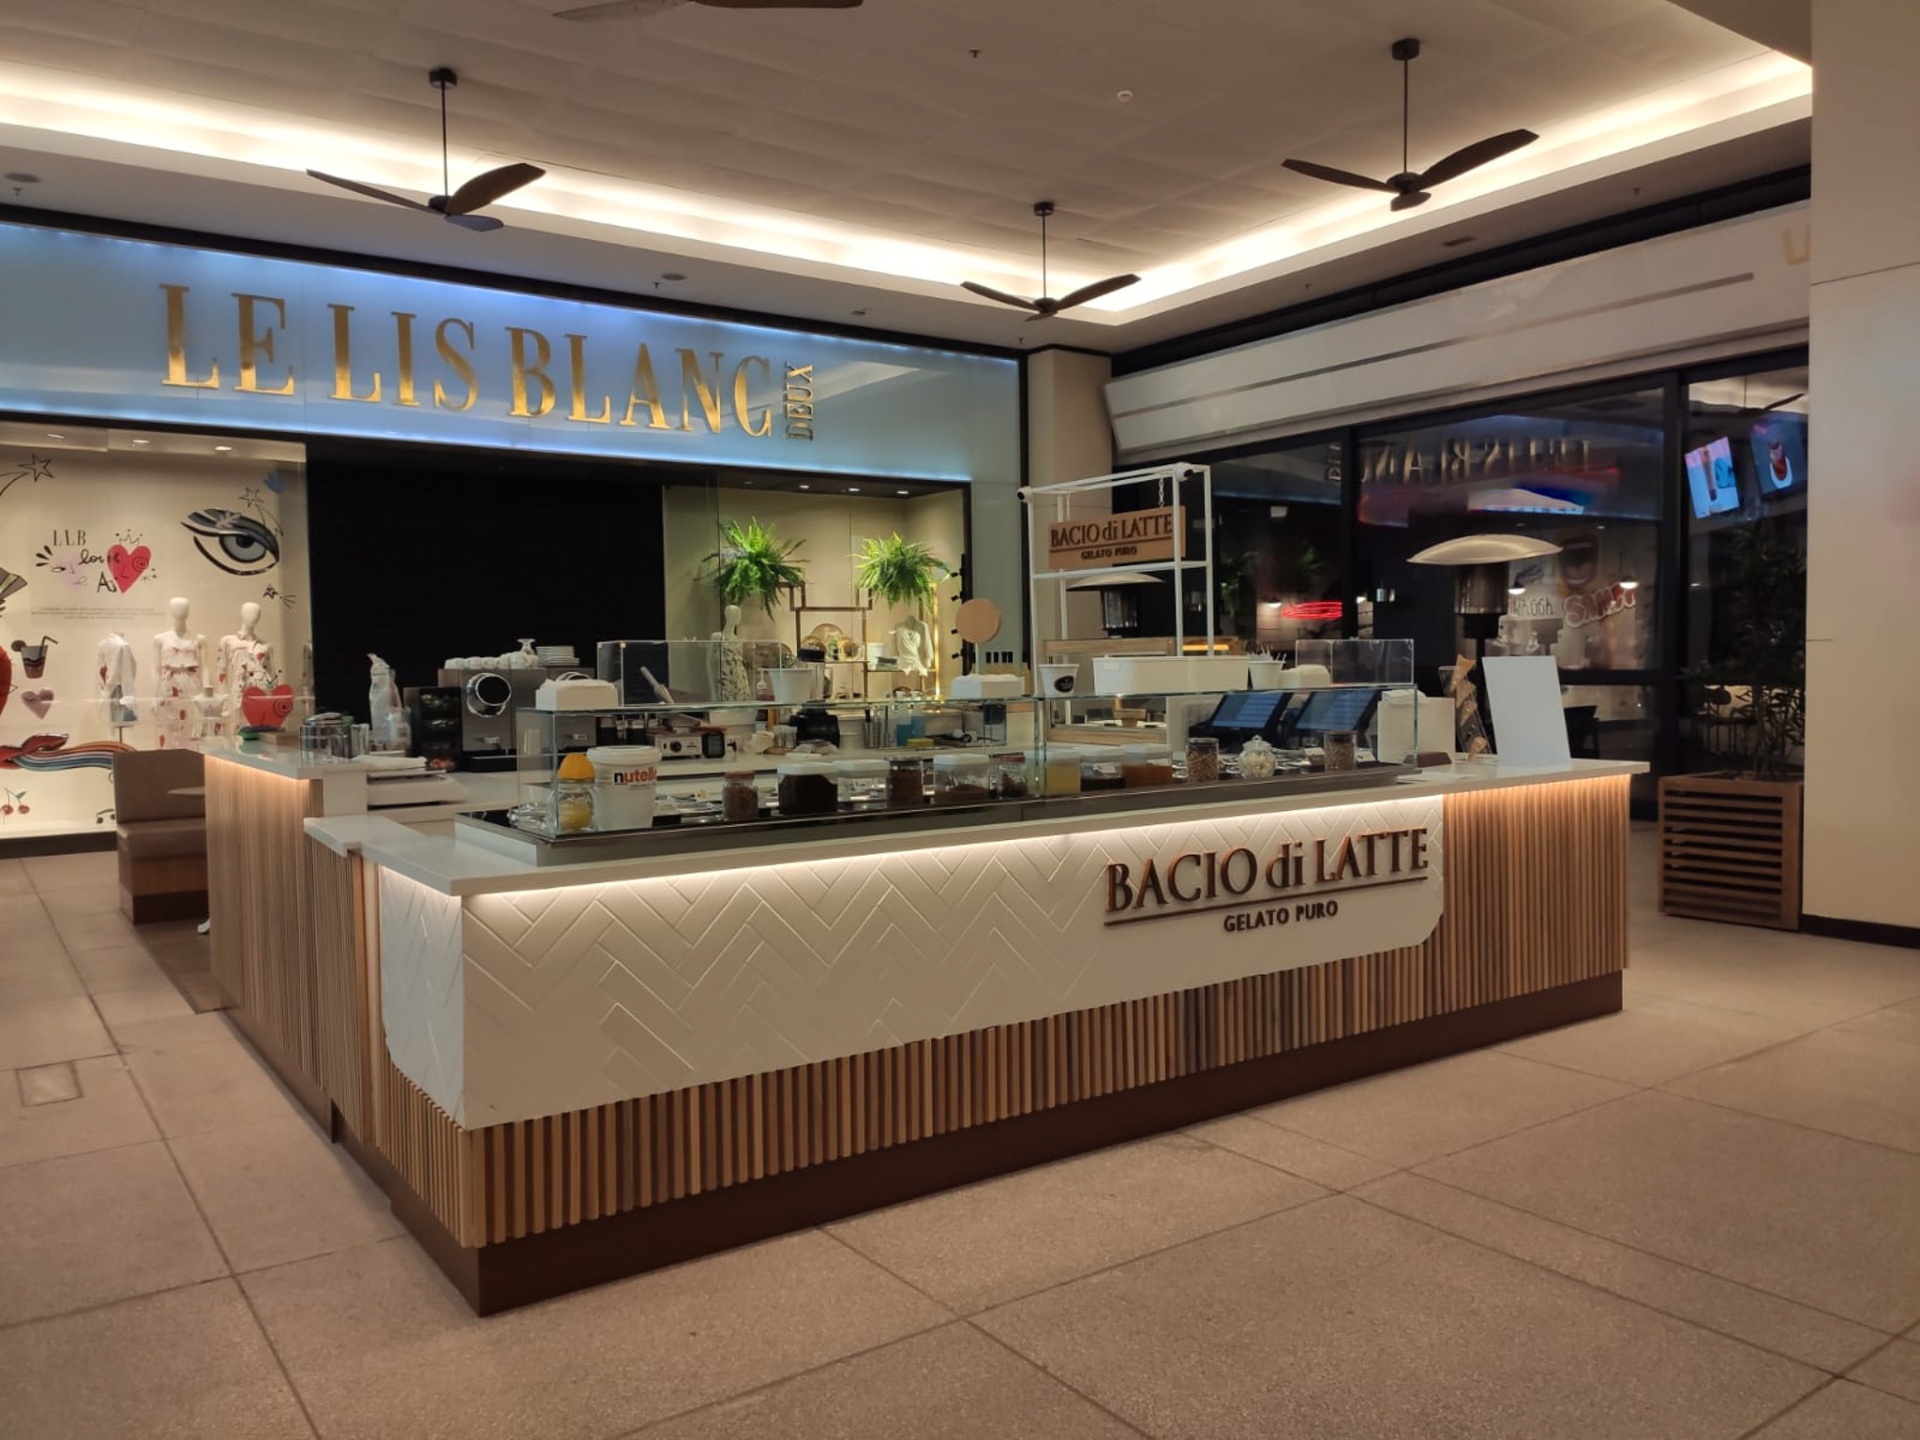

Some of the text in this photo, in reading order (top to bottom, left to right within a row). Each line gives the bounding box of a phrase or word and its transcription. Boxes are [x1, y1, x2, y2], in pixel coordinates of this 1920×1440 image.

[159, 283, 772, 437] LE LIS BLANC
[784, 360, 813, 441] DEUX
[52, 529, 87, 547] LLB
[1050, 513, 1172, 548] BACIO di LATTE
[1081, 546, 1138, 560] GELATO PURO
[1106, 828, 1429, 912] BACIO di LATTE
[1224, 900, 1338, 932] GELATO PURO
